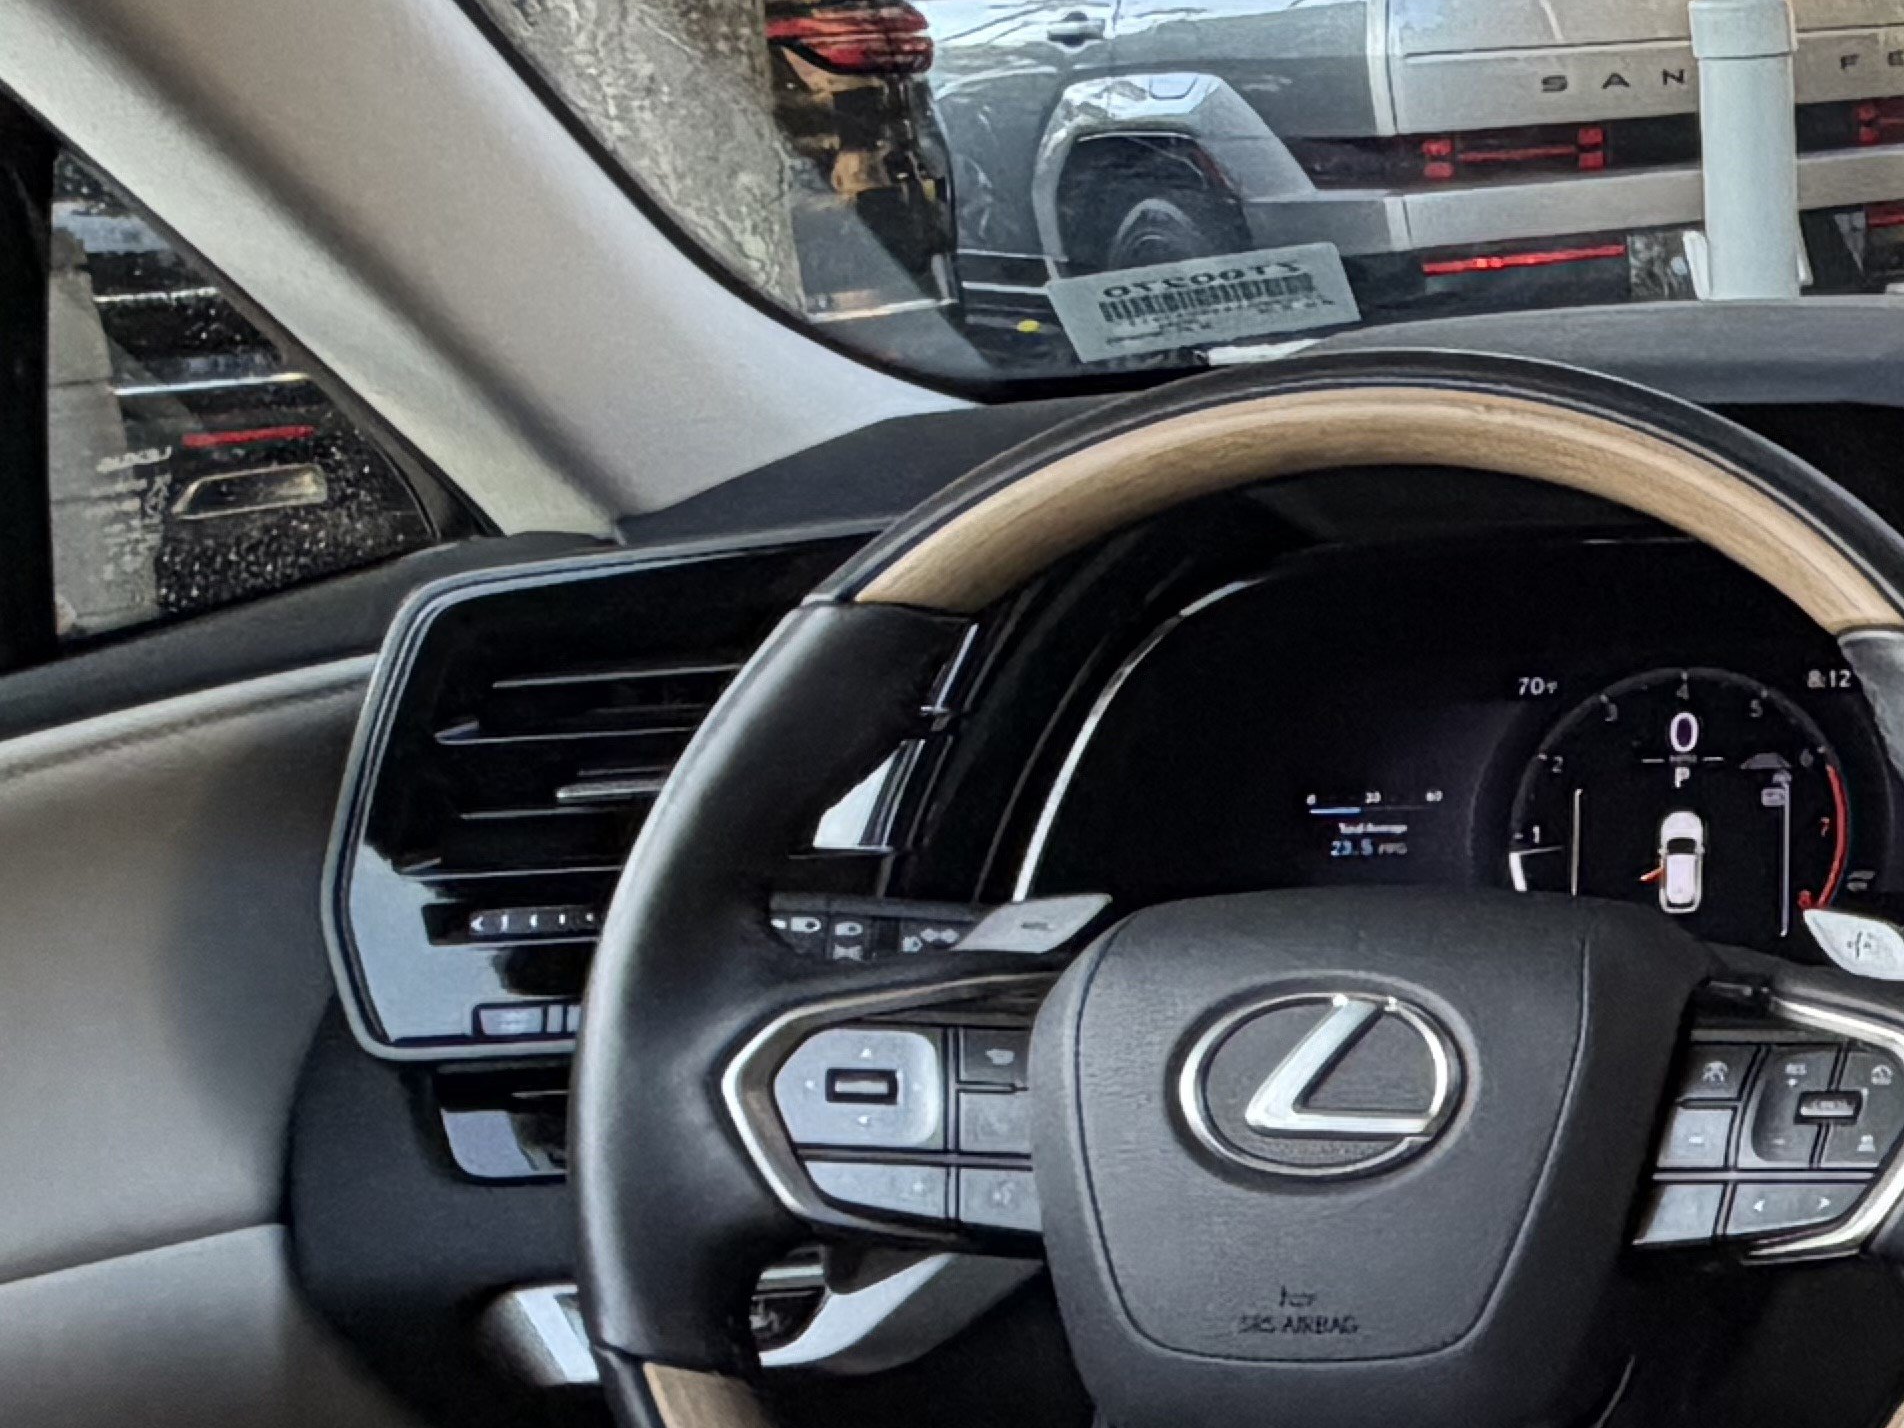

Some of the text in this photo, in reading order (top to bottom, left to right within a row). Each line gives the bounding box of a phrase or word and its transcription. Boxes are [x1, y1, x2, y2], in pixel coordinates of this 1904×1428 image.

[1840, 49, 1904, 71] FE
[1806, 669, 1851, 689] 8:12
[1669, 711, 1700, 753] 0
[1552, 755, 1564, 773] 2
[1674, 766, 1691, 789] P
[1532, 825, 1540, 844] 1
[1238, 1314, 1359, 1335] SRS AIRBAG
